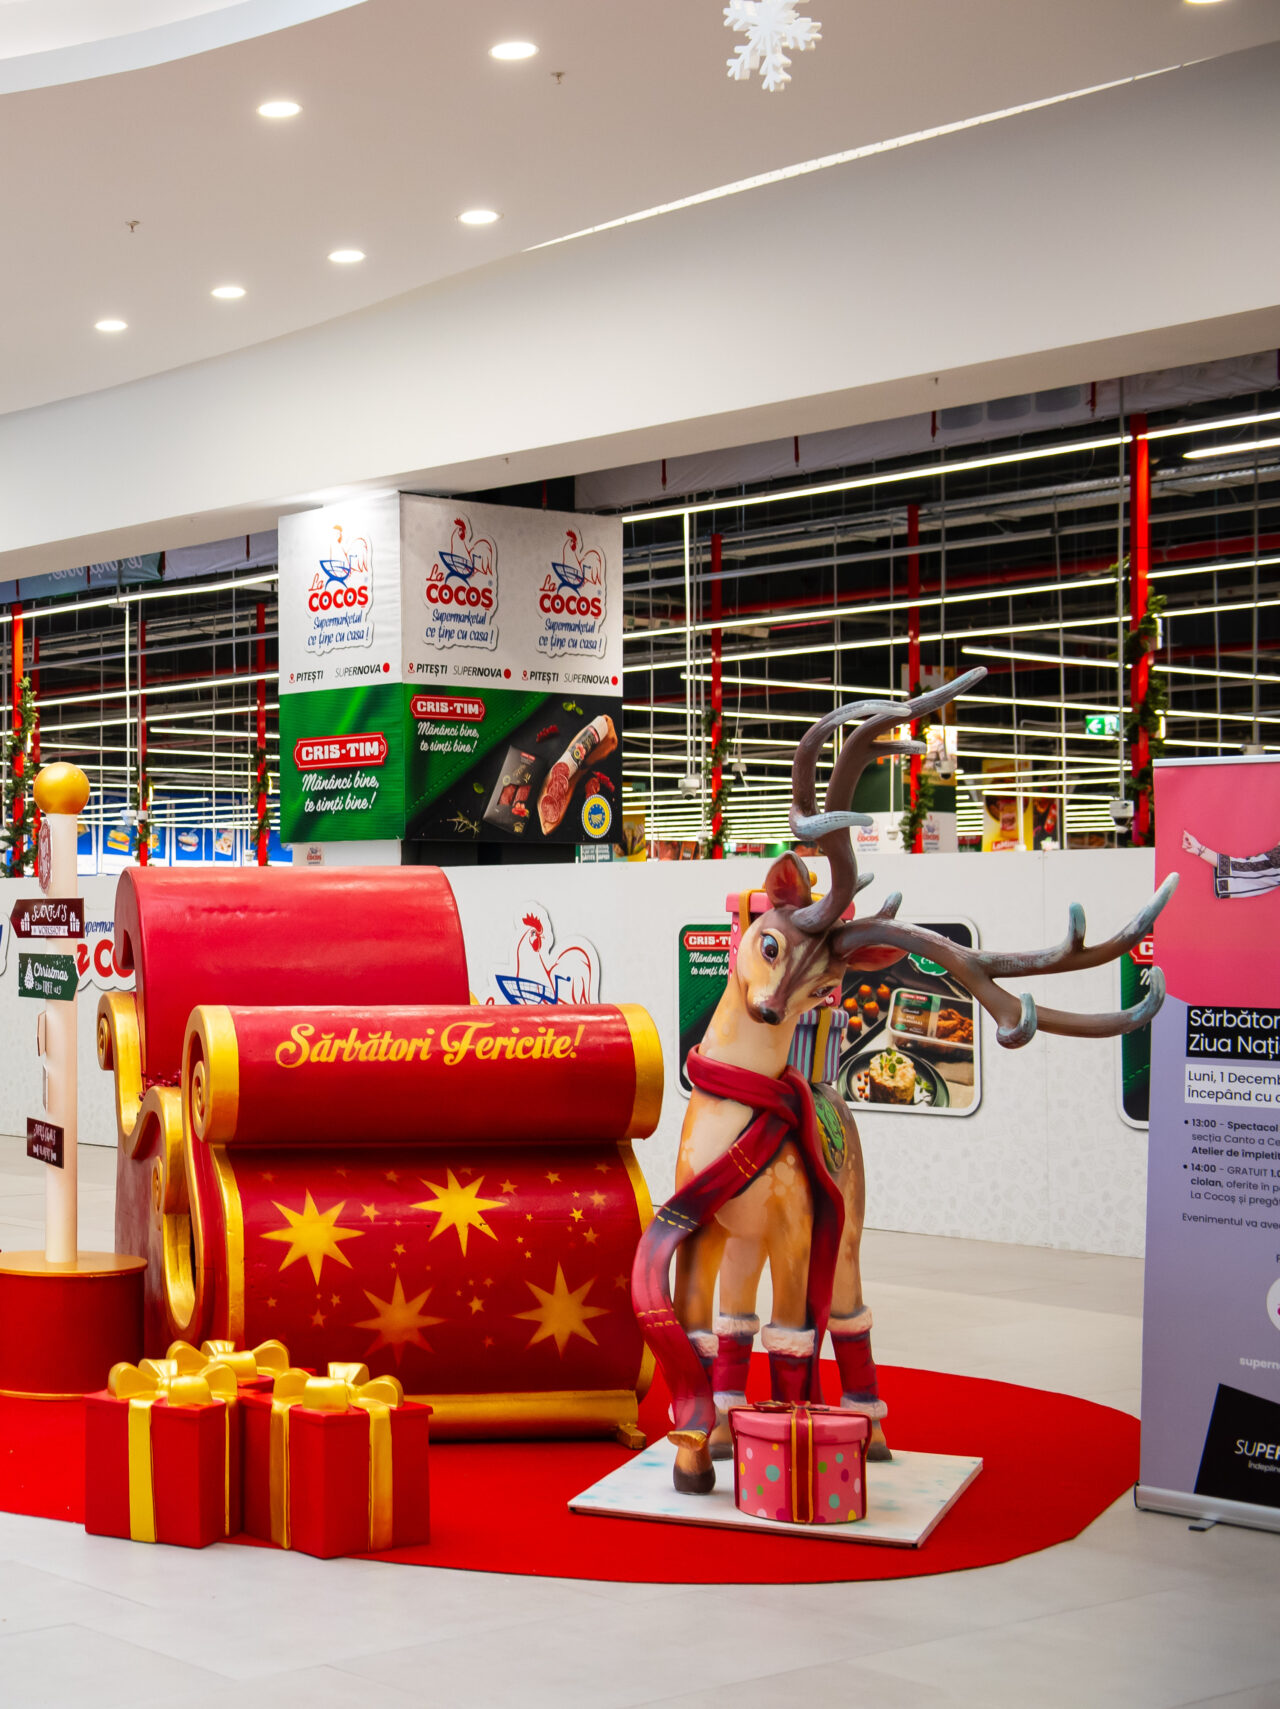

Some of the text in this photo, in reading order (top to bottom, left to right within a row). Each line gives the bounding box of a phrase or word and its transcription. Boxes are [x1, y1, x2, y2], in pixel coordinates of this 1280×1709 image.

[426, 564, 444, 582] La
[308, 573, 324, 591] La
[539, 574, 557, 592] La
[313, 610, 363, 631] Supermarketul
[432, 608, 487, 627] Supermarketul
[425, 626, 436, 638] ce
[457, 629, 467, 641] cu
[545, 618, 596, 635] Supermarketul
[335, 664, 381, 678] SUPERNOVA
[453, 665, 502, 678] SUPERNOVA
[564, 672, 610, 685] SUPERNOVA
[420, 740, 429, 751] te
[304, 798, 315, 812] te
[33, 962, 69, 981] Christmas
[275, 1021, 585, 1068] Sărbători Fericite!
[1189, 1033, 1280, 1060] Ziua Nați
[1188, 1070, 1217, 1084] Luni,
[1187, 1085, 1252, 1102] Începând
[1255, 1093, 1272, 1102] cu
[1192, 1118, 1216, 1128] 13:00
[1227, 1121, 1279, 1132] Spectacol
[1224, 1134, 1256, 1145] Canto
[1191, 1146, 1224, 1156] Atelier
[1226, 1149, 1239, 1157] de
[1191, 1163, 1216, 1173] 14:00
[1227, 1166, 1268, 1177] GRATUIT
[1190, 1177, 1223, 1188] ciolan,
[1226, 1180, 1258, 1190] oferite
[1190, 1190, 1201, 1199] La
[1182, 1213, 1242, 1226] Evenimentul
[1245, 1220, 1257, 1228] va
